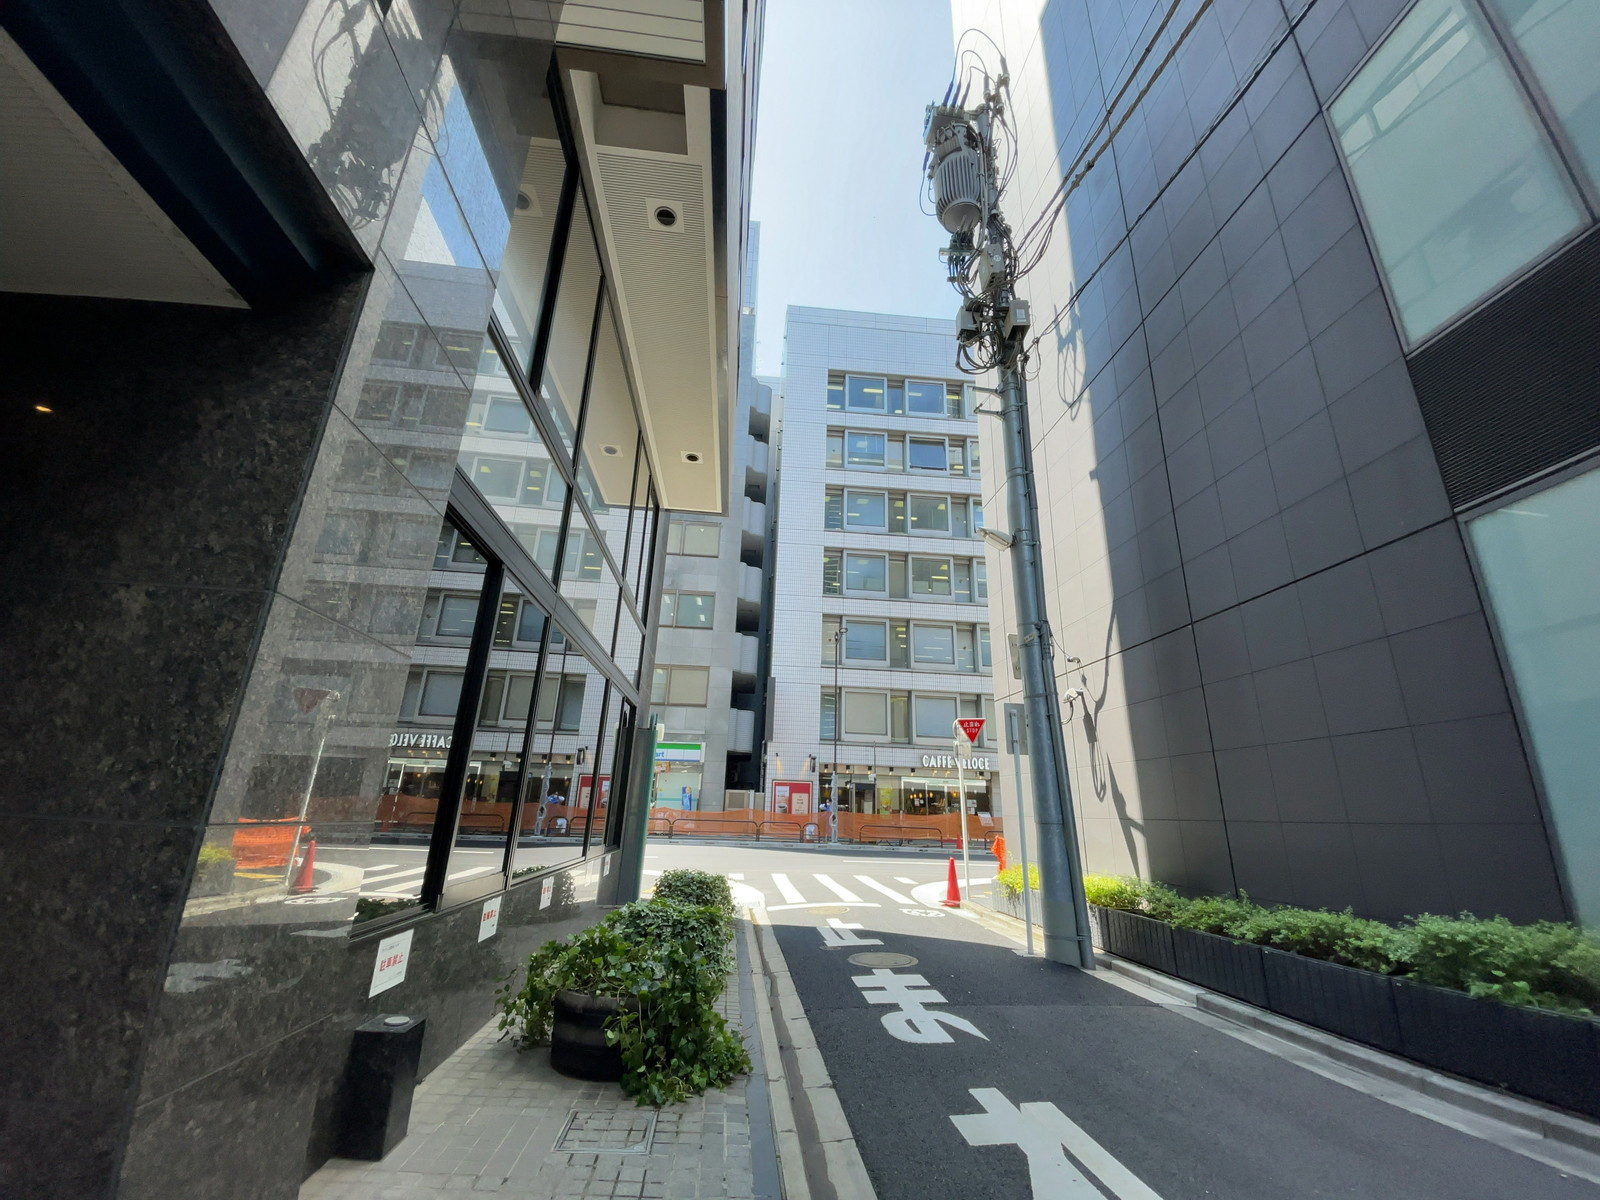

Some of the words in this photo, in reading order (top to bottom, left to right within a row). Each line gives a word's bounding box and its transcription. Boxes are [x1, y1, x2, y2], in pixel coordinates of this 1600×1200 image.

[922, 755, 952, 768] CAFFE
[379, 952, 404, 972] 駐車禁止
